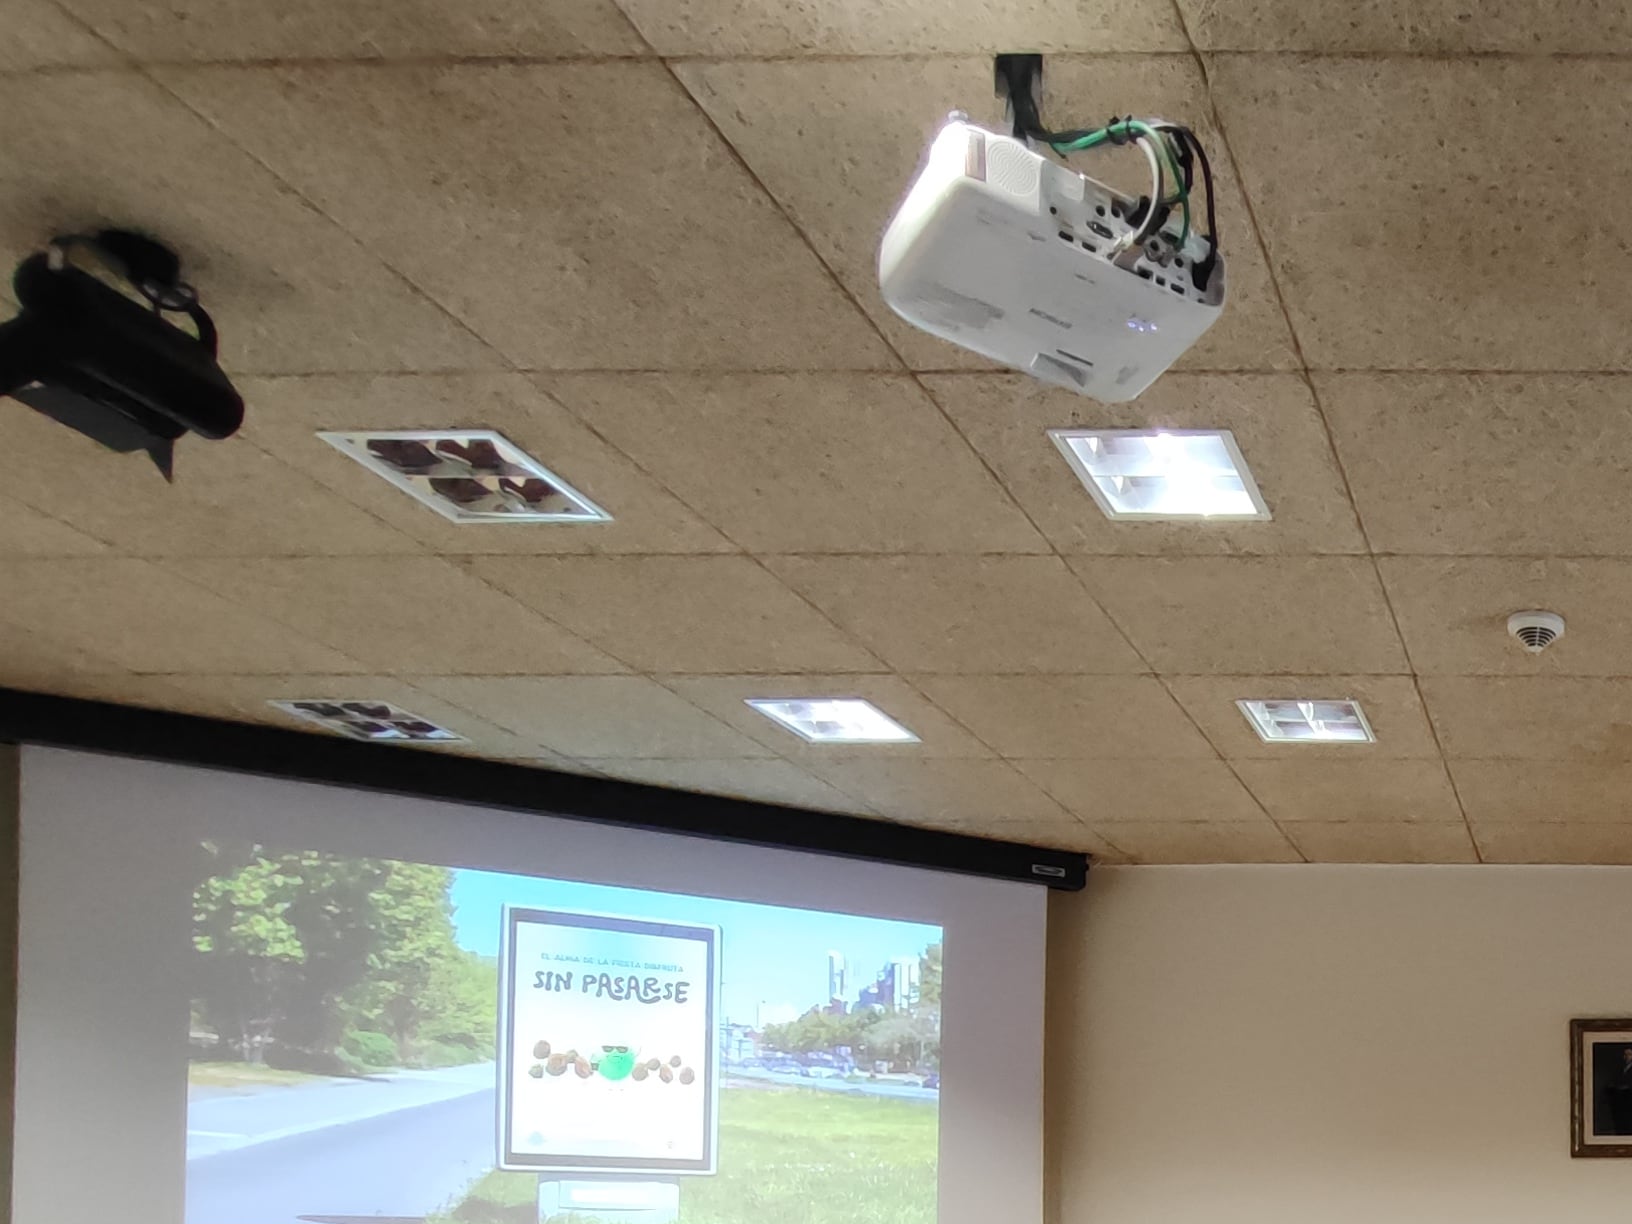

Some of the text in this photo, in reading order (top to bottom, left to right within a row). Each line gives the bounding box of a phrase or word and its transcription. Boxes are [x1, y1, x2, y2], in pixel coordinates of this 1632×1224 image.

[598, 958, 609, 966] LA
[533, 970, 690, 1004] SIN PASARSE
